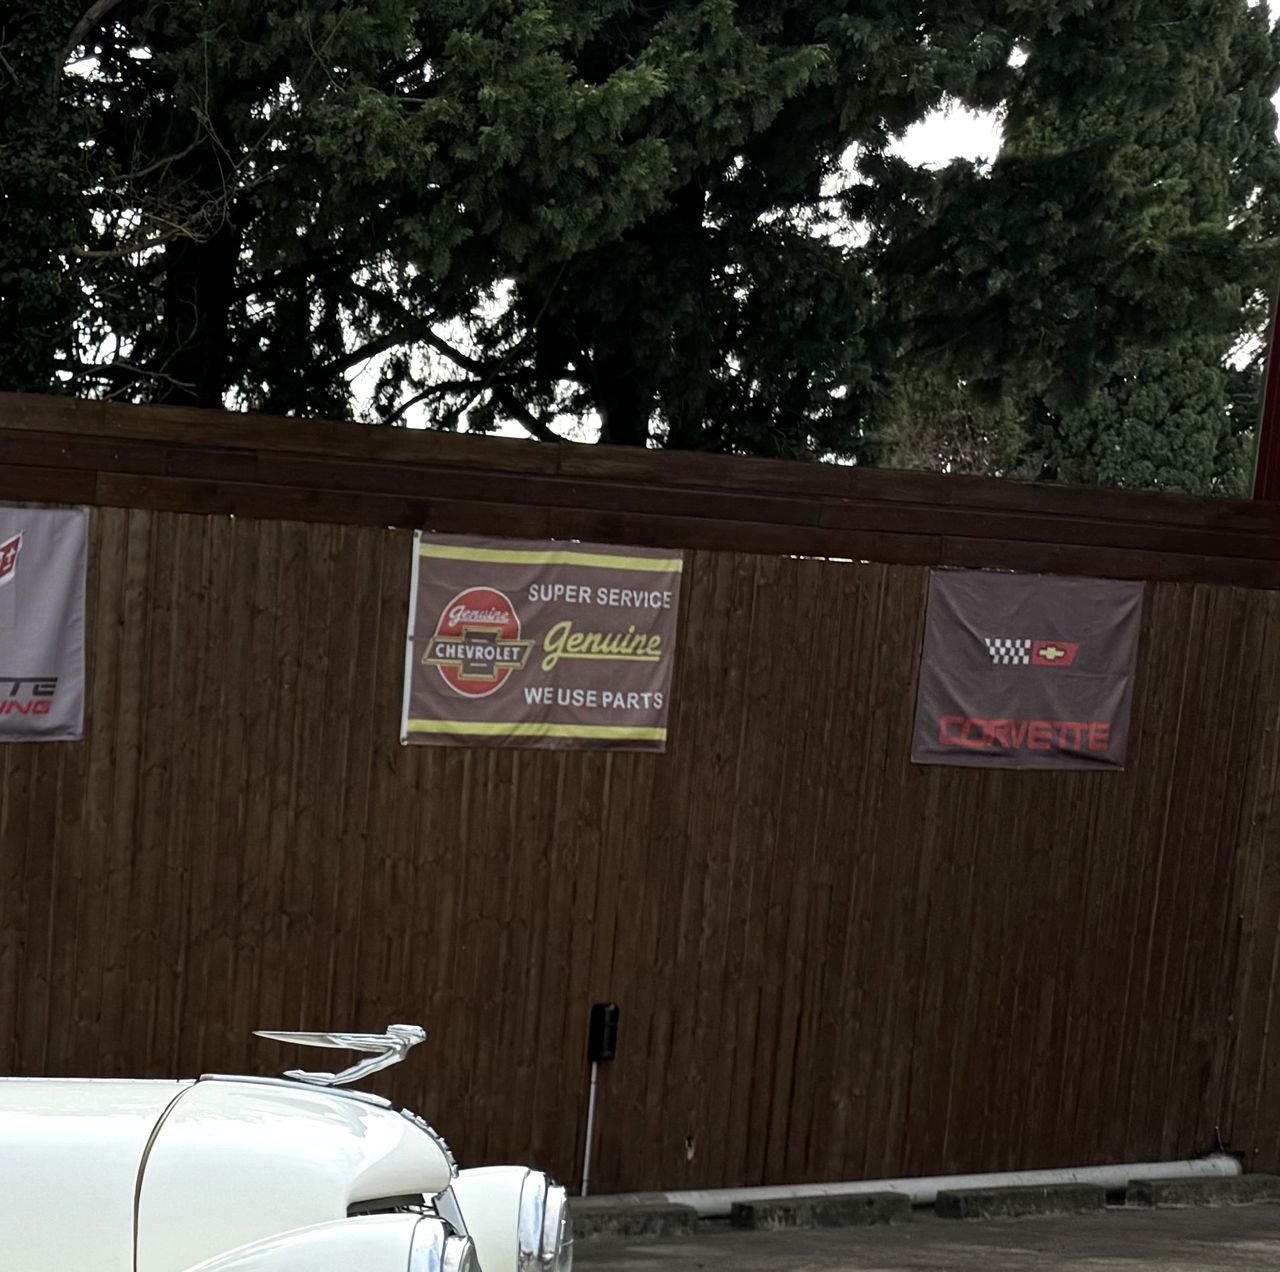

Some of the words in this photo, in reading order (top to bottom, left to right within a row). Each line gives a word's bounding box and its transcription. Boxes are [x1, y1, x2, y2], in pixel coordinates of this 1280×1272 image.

[528, 583, 591, 604] SUPER
[596, 587, 672, 609] SERVICE
[448, 604, 510, 627] Genuine
[435, 643, 521, 661] CHEVROLET
[541, 621, 663, 672] Genuine
[524, 687, 553, 705] WE
[558, 688, 597, 707] USE
[602, 691, 664, 710] PARTS
[940, 715, 1112, 751] CORVETTE
